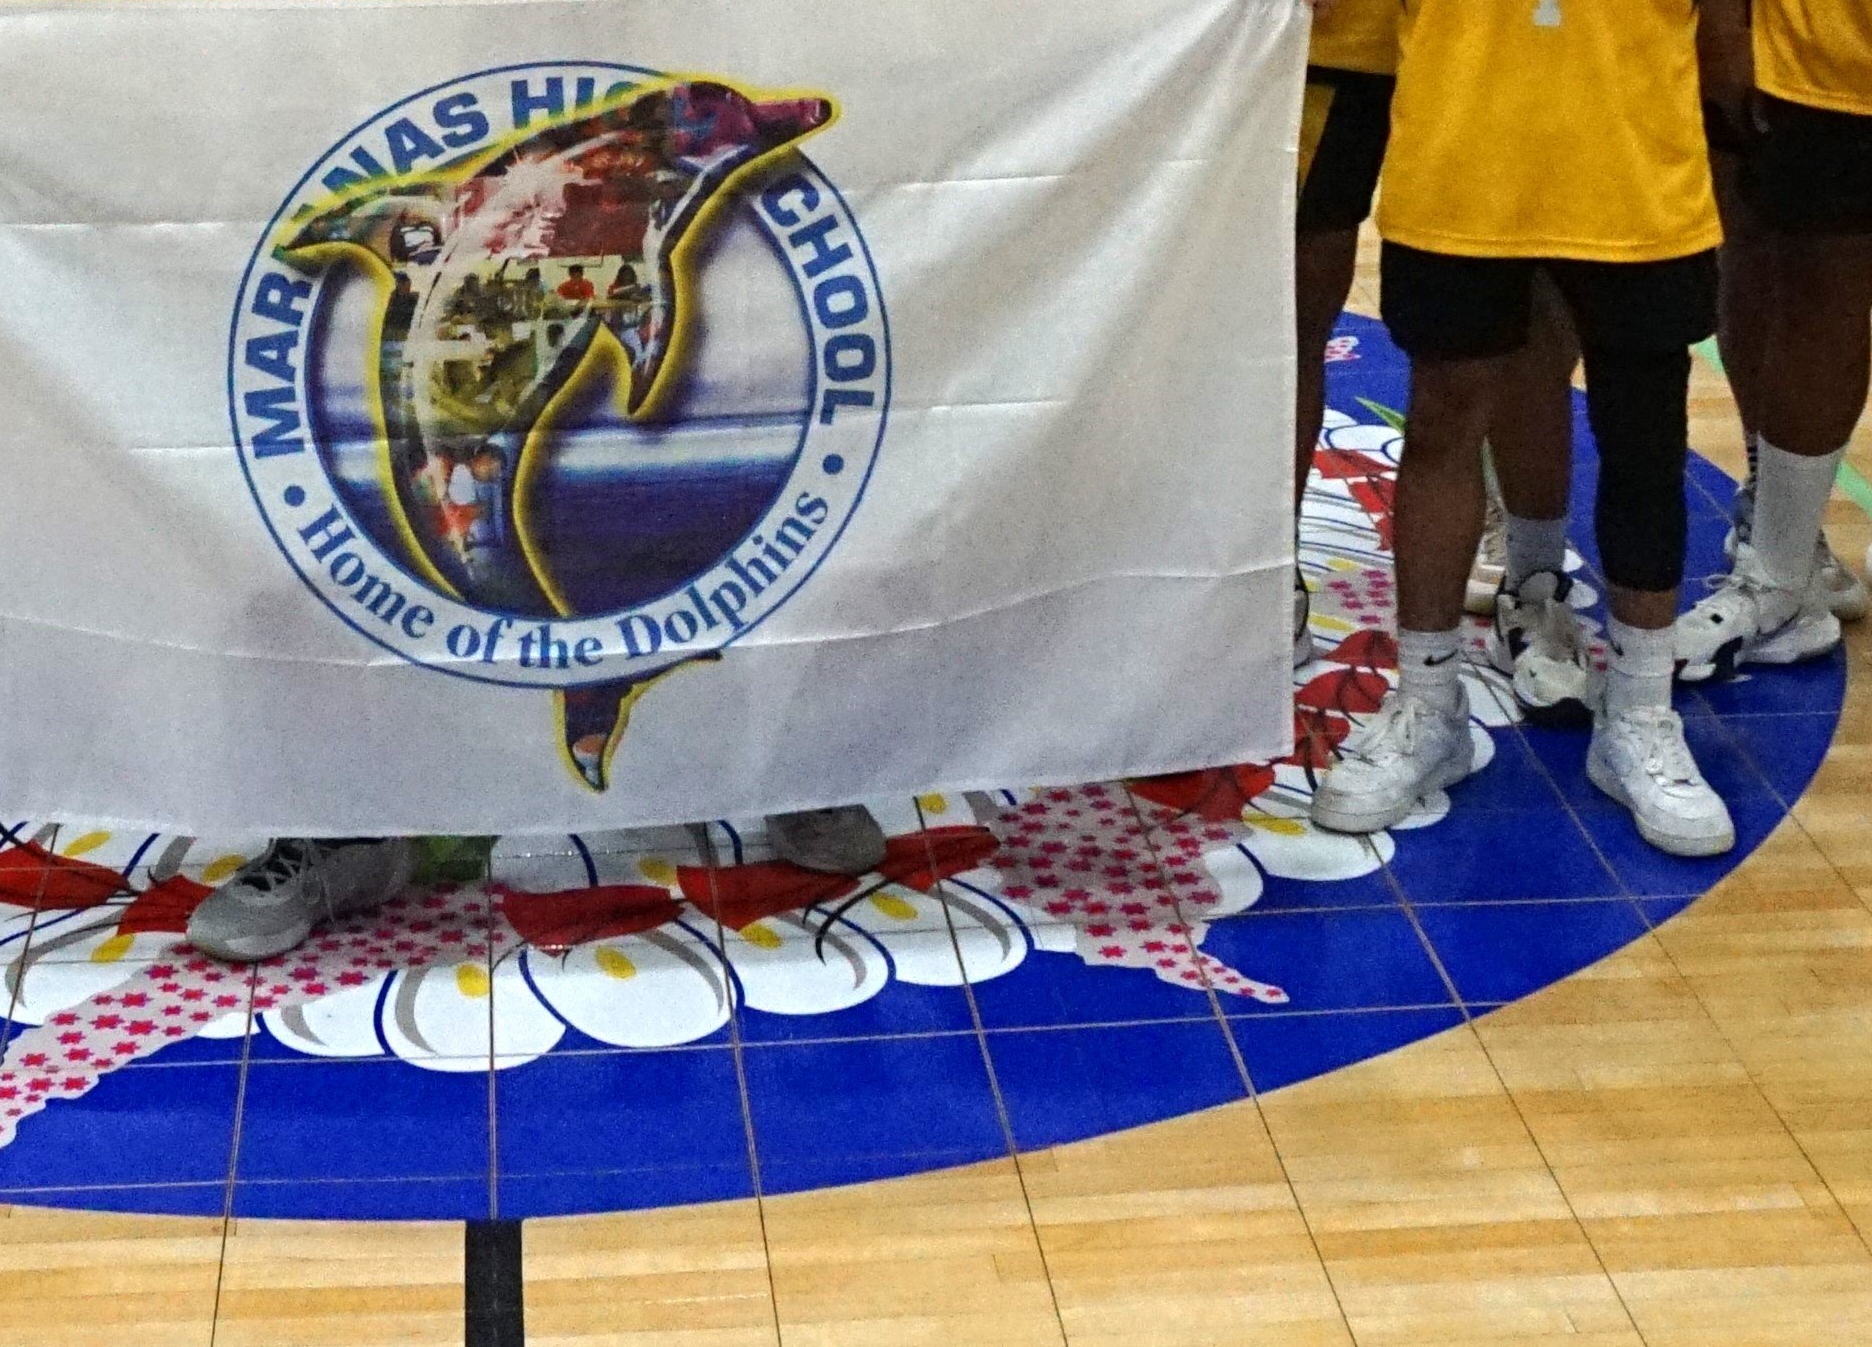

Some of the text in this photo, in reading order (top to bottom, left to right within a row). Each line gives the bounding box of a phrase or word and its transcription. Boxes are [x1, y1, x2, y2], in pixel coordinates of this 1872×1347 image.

[244, 92, 490, 459] MARNAS
[297, 490, 829, 669] Home of the Dolphins
